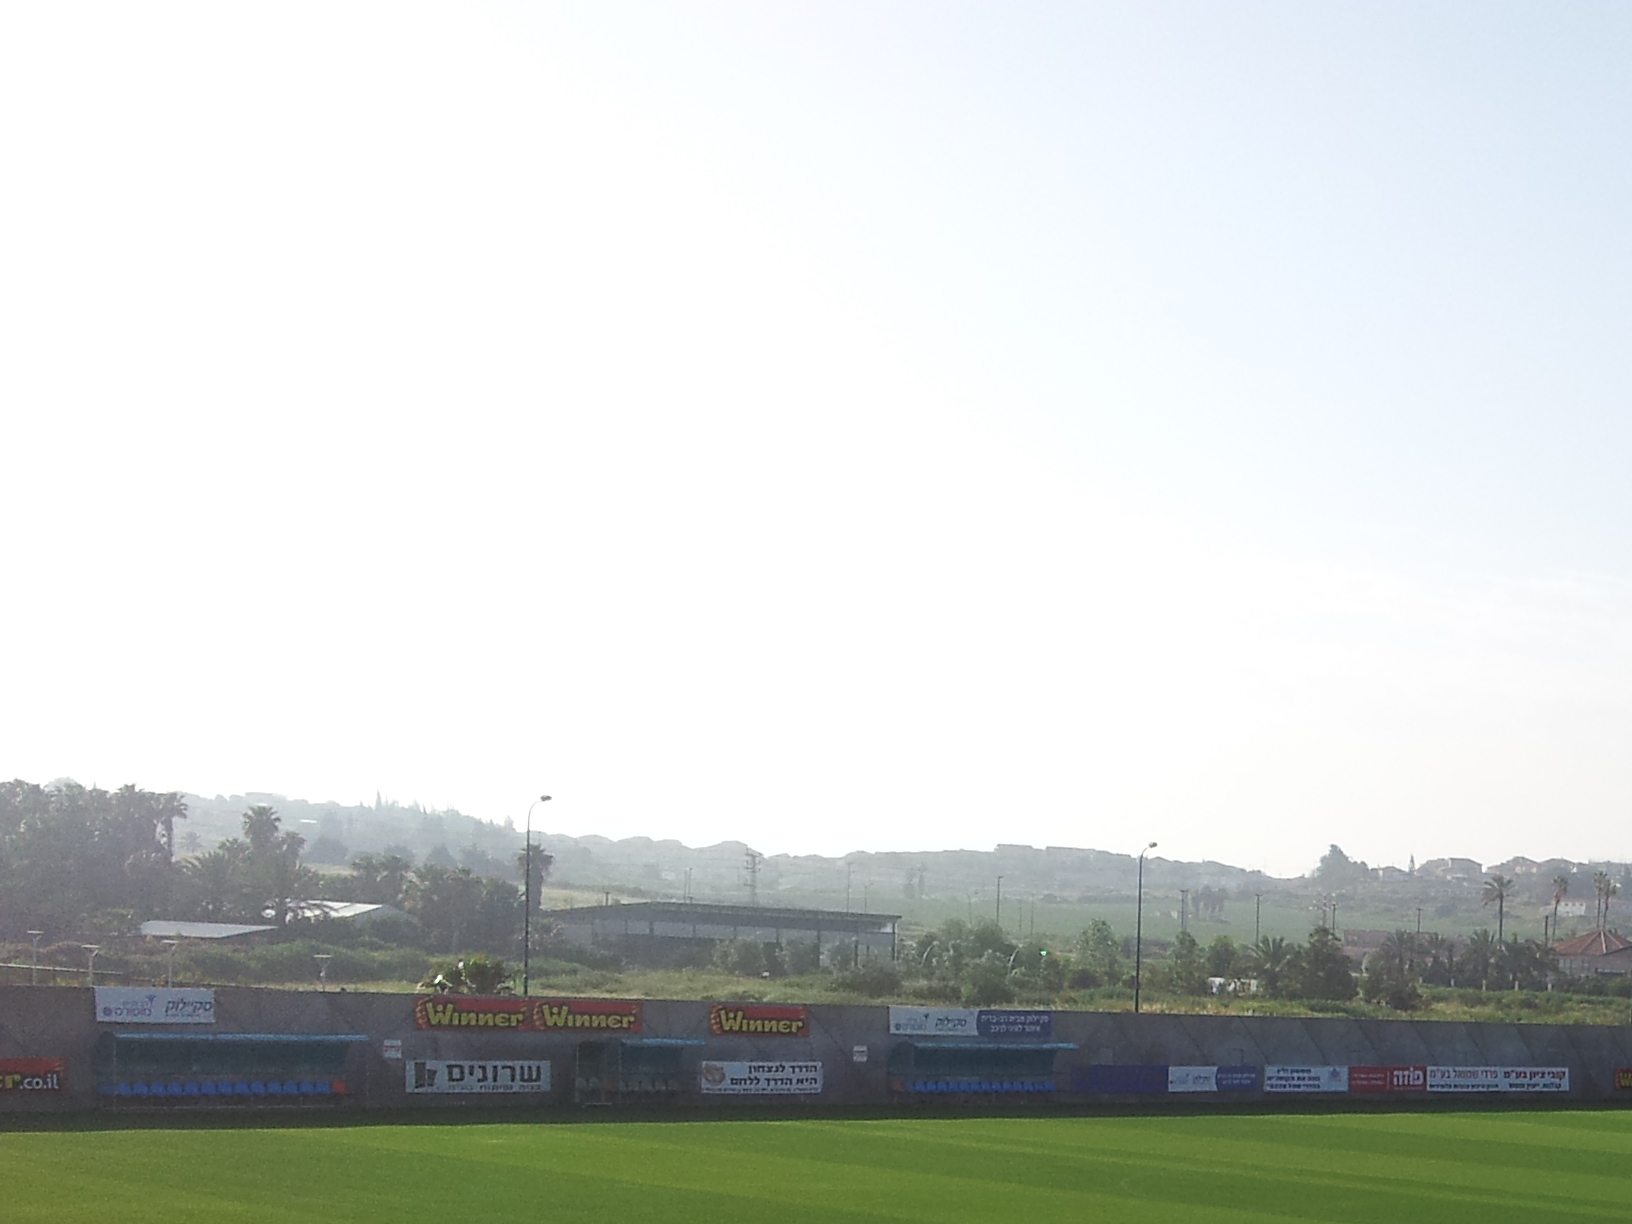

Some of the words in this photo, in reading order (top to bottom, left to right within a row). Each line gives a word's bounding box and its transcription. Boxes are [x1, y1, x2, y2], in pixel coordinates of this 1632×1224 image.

[426, 1002, 524, 1028] Winner
[542, 1003, 635, 1029] Winner
[719, 1009, 804, 1033] Winner
[446, 1064, 542, 1083] שרונים
